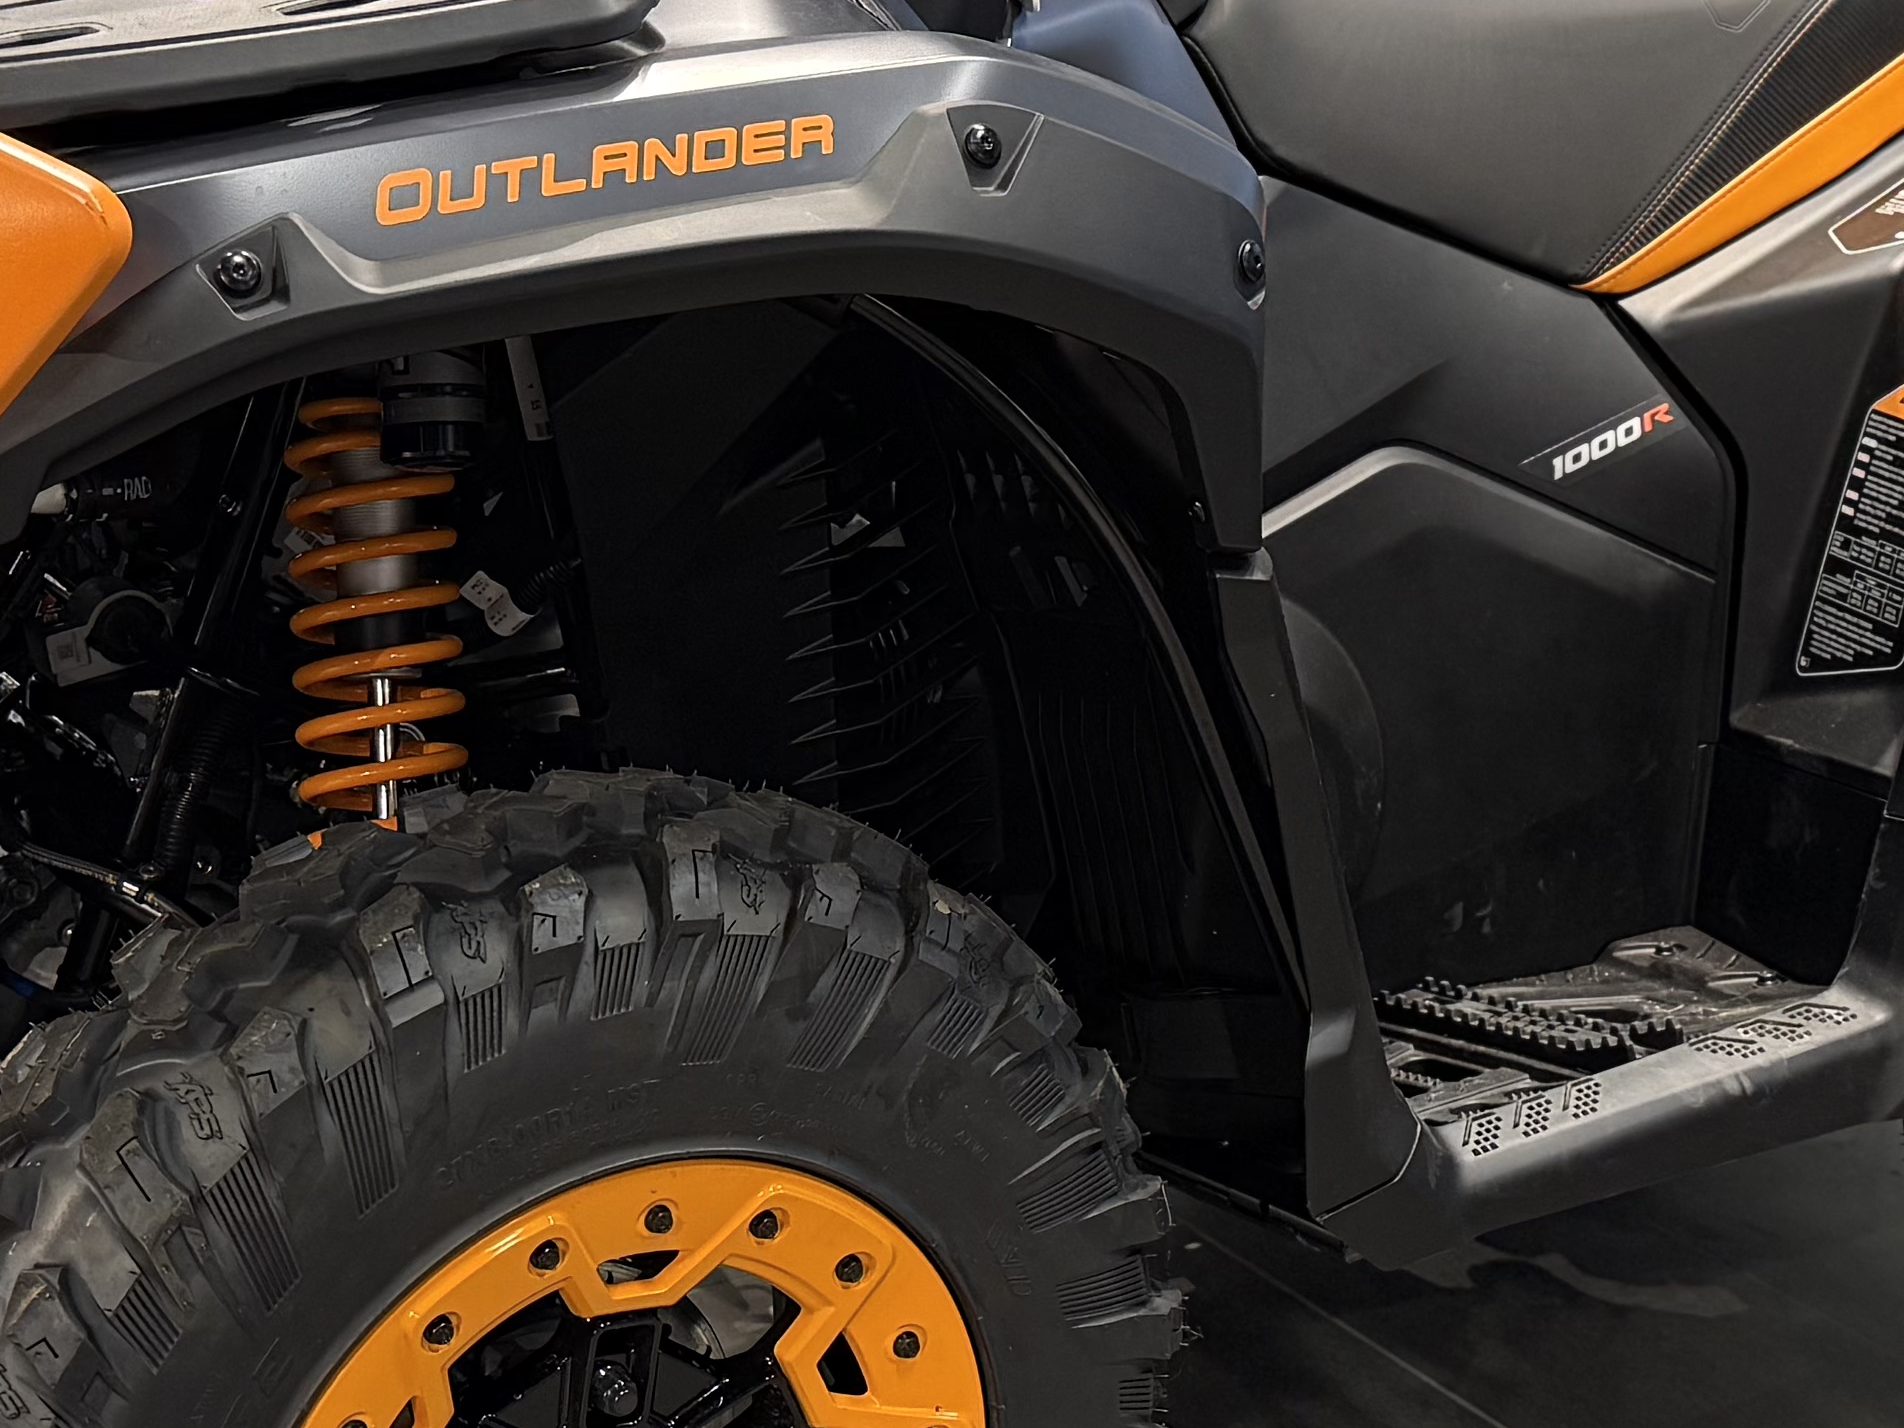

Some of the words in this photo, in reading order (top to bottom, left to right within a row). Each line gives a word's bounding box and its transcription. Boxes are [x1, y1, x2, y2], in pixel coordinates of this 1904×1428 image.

[376, 113, 835, 226] OUTLANDER
[1552, 402, 1675, 481] 1000R
[163, 1072, 224, 1141] XPS
